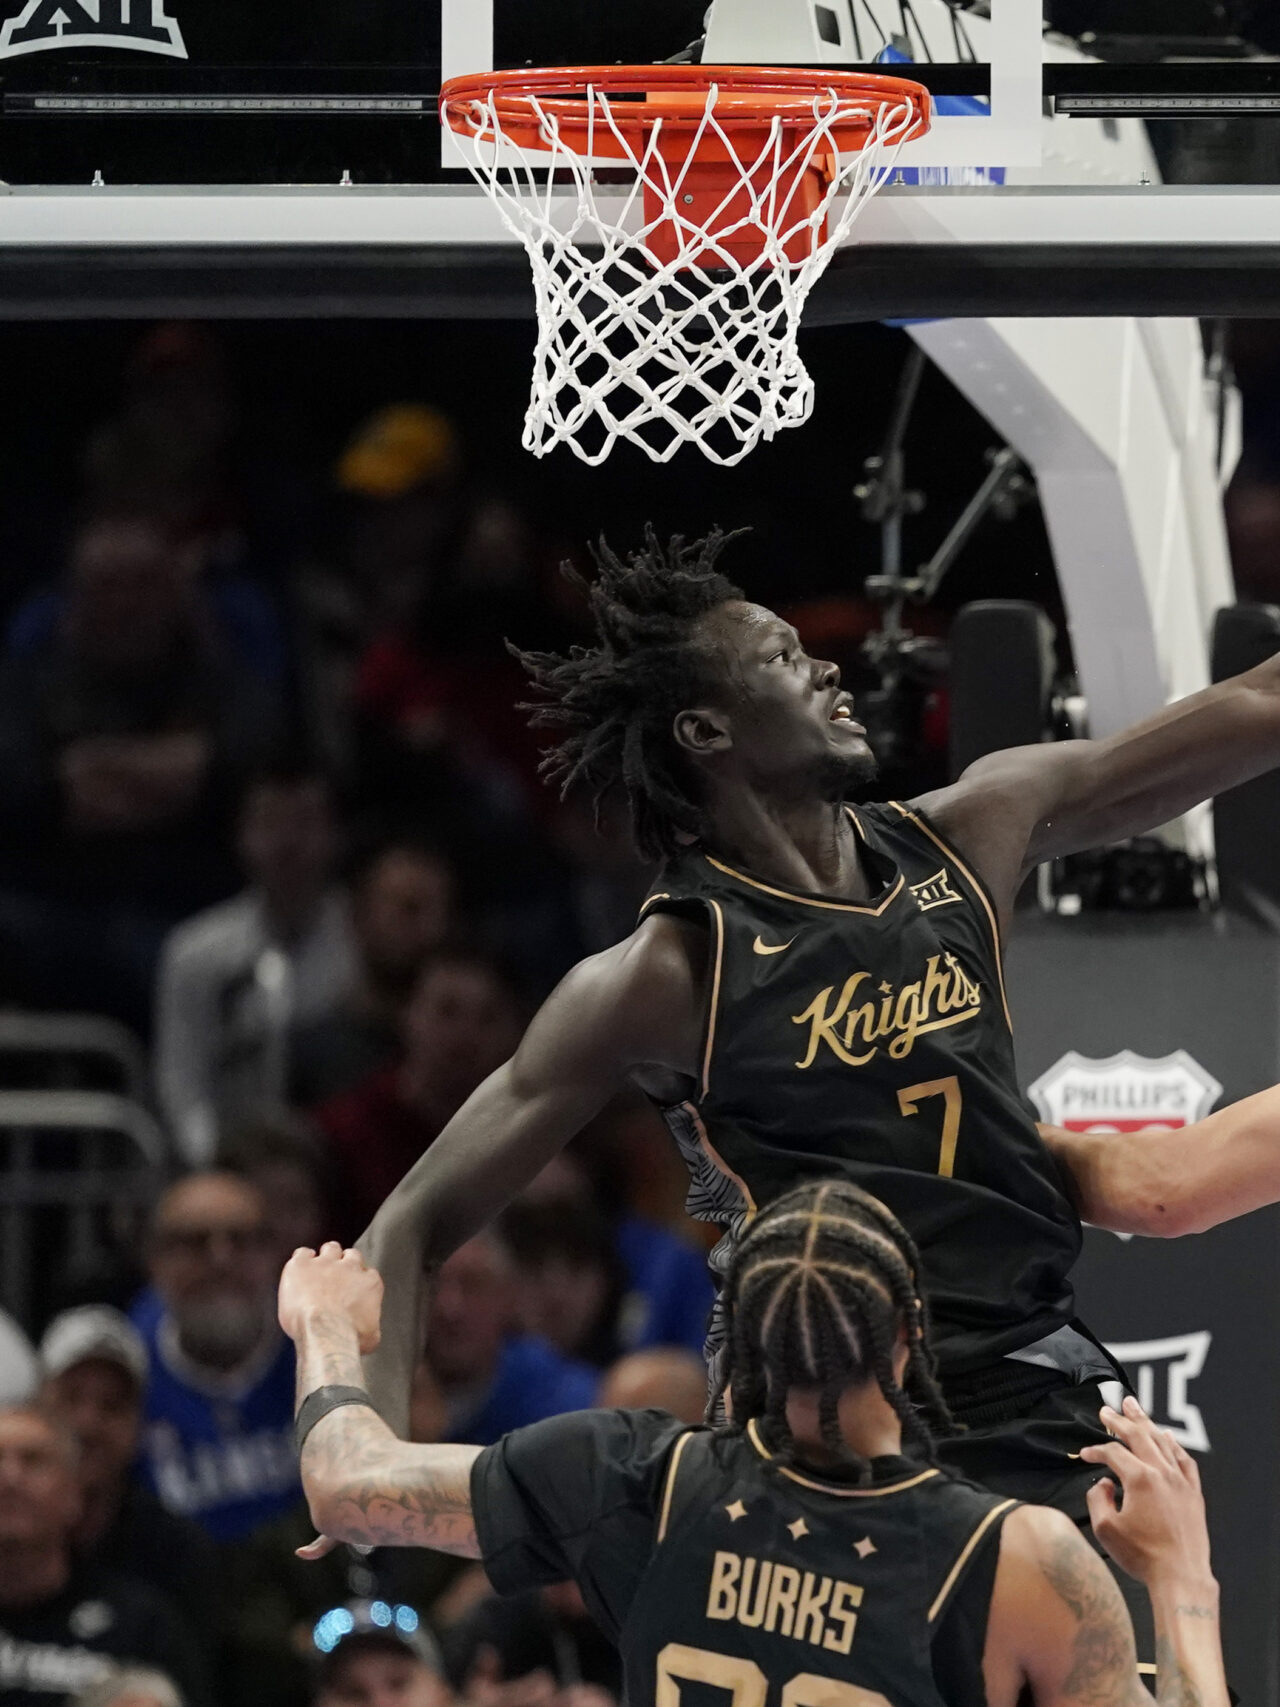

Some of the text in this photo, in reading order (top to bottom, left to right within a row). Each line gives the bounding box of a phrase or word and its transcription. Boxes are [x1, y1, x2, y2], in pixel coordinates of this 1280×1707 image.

[792, 951, 980, 1069] Knights
[897, 1075, 962, 1177] 7
[1061, 1081, 1188, 1107] PHILLIPS
[706, 1550, 864, 1655] BURKS
